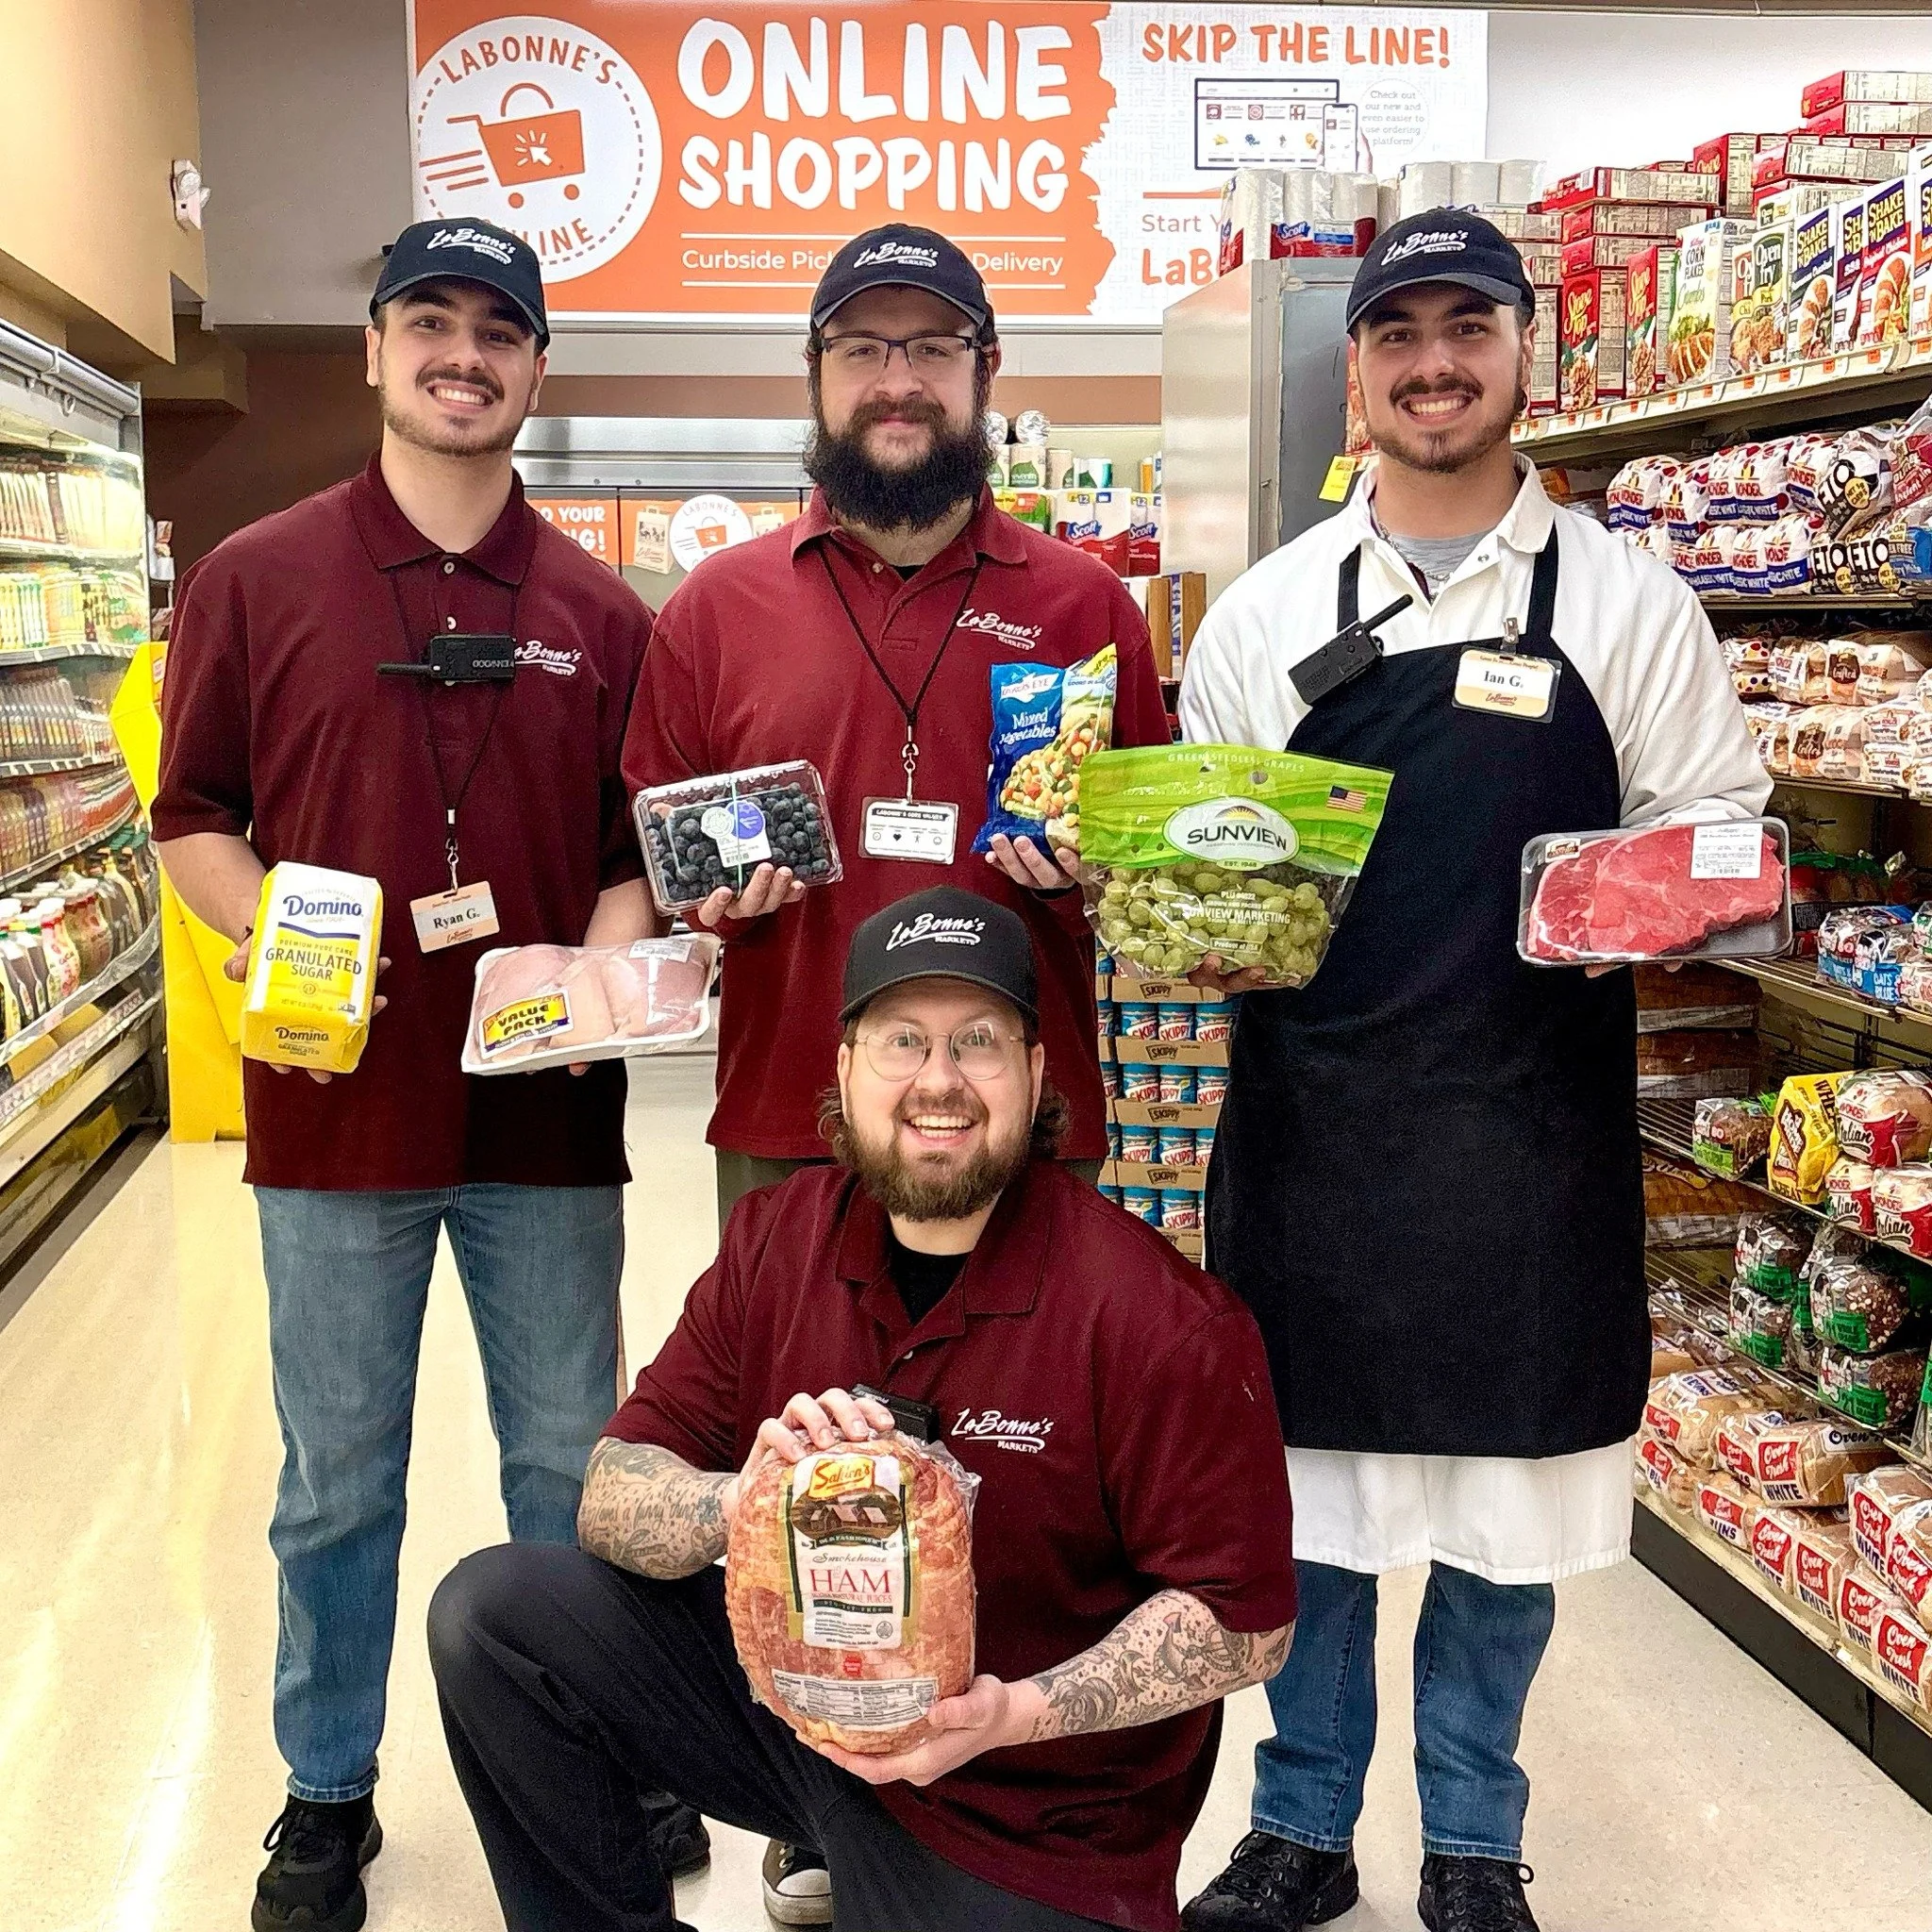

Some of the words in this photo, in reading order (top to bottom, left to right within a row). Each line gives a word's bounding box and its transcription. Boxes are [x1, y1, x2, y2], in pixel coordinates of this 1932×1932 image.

[1141, 23, 1237, 64] SKIP
[1250, 22, 1330, 64] THE
[1344, 25, 1451, 69] LINE!
[439, 35, 618, 84] LABONNE'S
[677, 16, 1074, 123] ONLINE
[1370, 90, 1398, 99] Check
[1382, 125, 1422, 136] ordering
[677, 132, 1070, 213] SHOPPING
[1869, 189, 1905, 227] SHAKE
[1141, 214, 1202, 233] Start
[1797, 217, 1828, 251] SHAKE
[1844, 214, 1863, 241] SH
[1876, 208, 1905, 242] BAKE
[426, 227, 517, 255] LaBonne's
[1380, 229, 1469, 266] LaBonne's
[1803, 234, 1827, 268] BAKE
[681, 249, 787, 271] Curbside
[972, 252, 1064, 276] Delivery
[853, 242, 940, 269] LaBonne's
[1141, 248, 1214, 286] LaB
[1686, 245, 1706, 266] CORN
[558, 506, 607, 523] YOUR
[956, 608, 1042, 639] LaBonne's
[1484, 670, 1505, 685] Ian
[1508, 675, 1524, 689] G.
[1012, 706, 1049, 729] Mixed
[1186, 824, 1288, 851] SUNVIEW
[282, 894, 362, 917] Domino
[433, 912, 464, 929] Ryan
[466, 907, 481, 920] G.
[1233, 908, 1291, 924] MARKETING
[886, 912, 987, 952] LaBonne's
[265, 947, 362, 975] GRANULATED
[291, 963, 333, 981] SUGAR
[497, 1004, 550, 1027] VALUE
[503, 1014, 546, 1036] PACK
[275, 1026, 330, 1042] Domino
[951, 1407, 1055, 1437] LaBonne's
[997, 1440, 1039, 1454] MARKETS
[1829, 1429, 1870, 1445] Oven
[1763, 1443, 1791, 1464] Oven
[1763, 1483, 1804, 1501] WHITE
[1757, 1524, 1788, 1545] Oven
[812, 1552, 888, 1563] Smokehouse
[1856, 1531, 1887, 1578] WHITE
[1892, 1545, 1928, 1576] Oven
[809, 1569, 891, 1593] HAM
[866, 1592, 892, 1603] JUICES
[1799, 1584, 1835, 1622] WHITE
[1889, 1624, 1917, 1649] Oven
[1886, 1645, 1913, 1671] Fresh
[1879, 1658, 1922, 1704] WHITE
